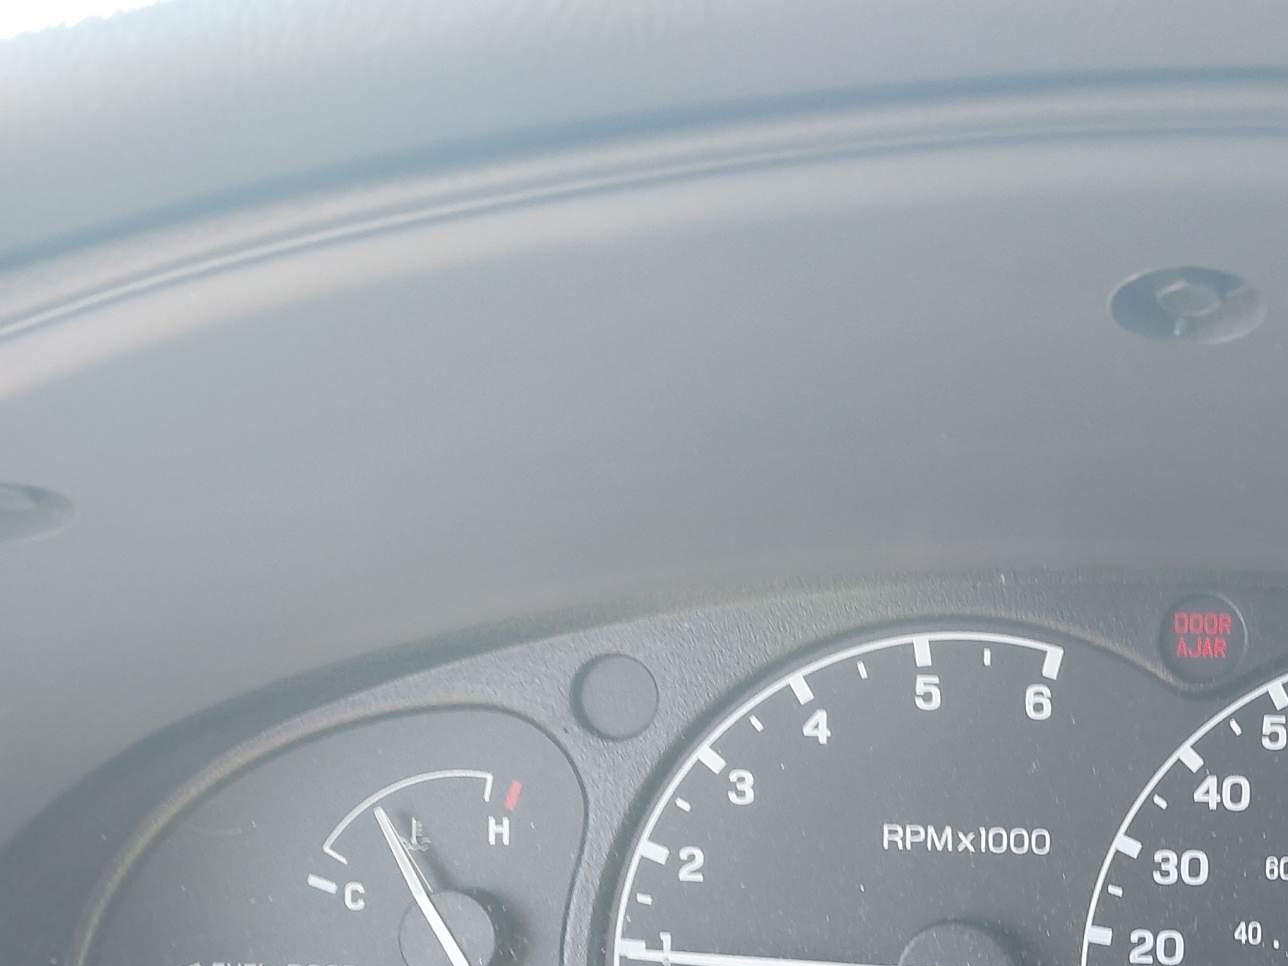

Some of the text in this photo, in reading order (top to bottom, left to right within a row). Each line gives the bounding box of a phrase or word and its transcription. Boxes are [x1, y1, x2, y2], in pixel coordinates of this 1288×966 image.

[1177, 637, 1226, 656] AJAR
[915, 675, 941, 711] 5
[1025, 684, 1052, 720] 6
[803, 709, 830, 744] 4
[728, 769, 754, 805] 3
[1194, 775, 1250, 811] 40
[488, 818, 510, 845] H
[883, 823, 1051, 856] RPMx1000
[678, 849, 704, 882] 2
[1153, 850, 1209, 886] 30
[344, 883, 365, 910] C
[659, 931, 672, 966] 1
[1129, 930, 1184, 966] 20
[1234, 922, 1262, 946] 40
